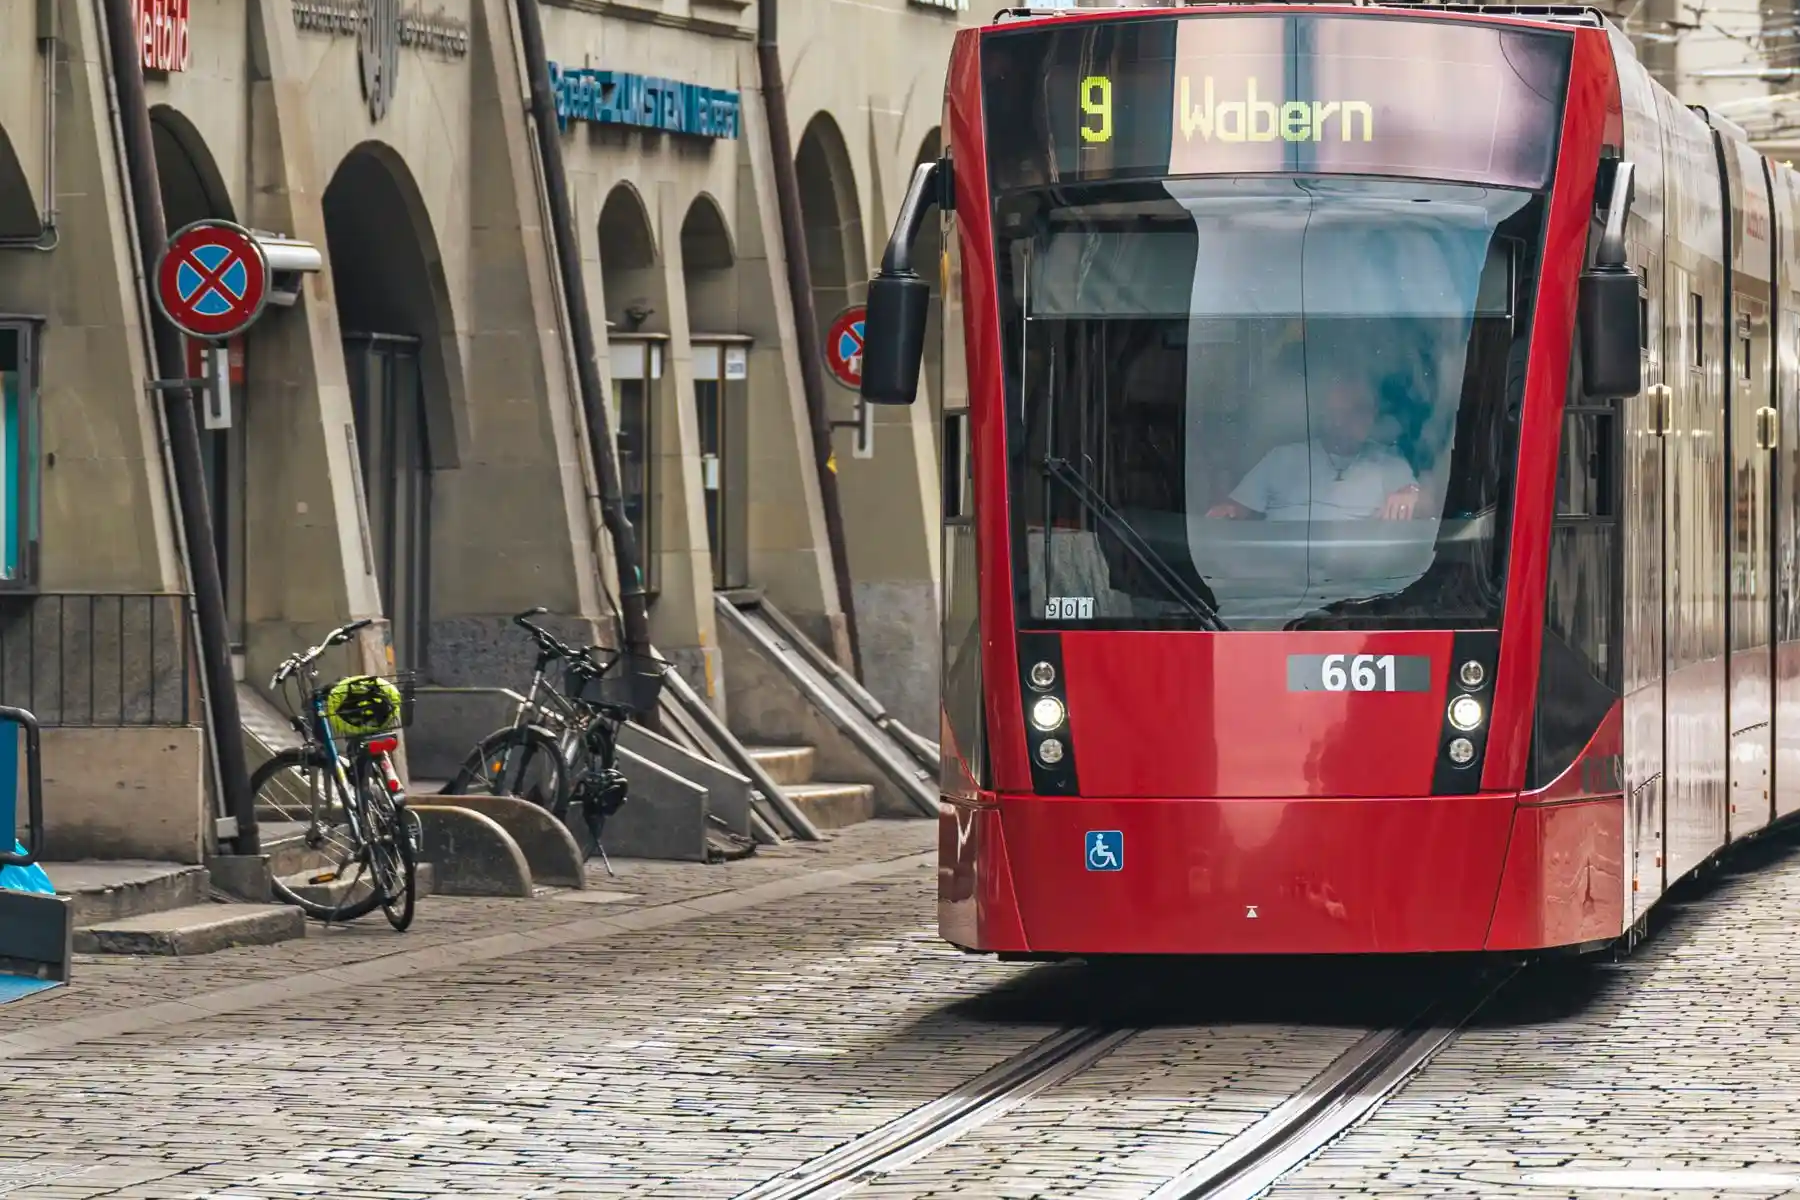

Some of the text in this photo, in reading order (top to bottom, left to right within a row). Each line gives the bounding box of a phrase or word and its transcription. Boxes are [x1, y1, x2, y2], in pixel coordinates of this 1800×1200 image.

[1081, 75, 1373, 143] 9 Wabern
[1321, 653, 1396, 692] 661
